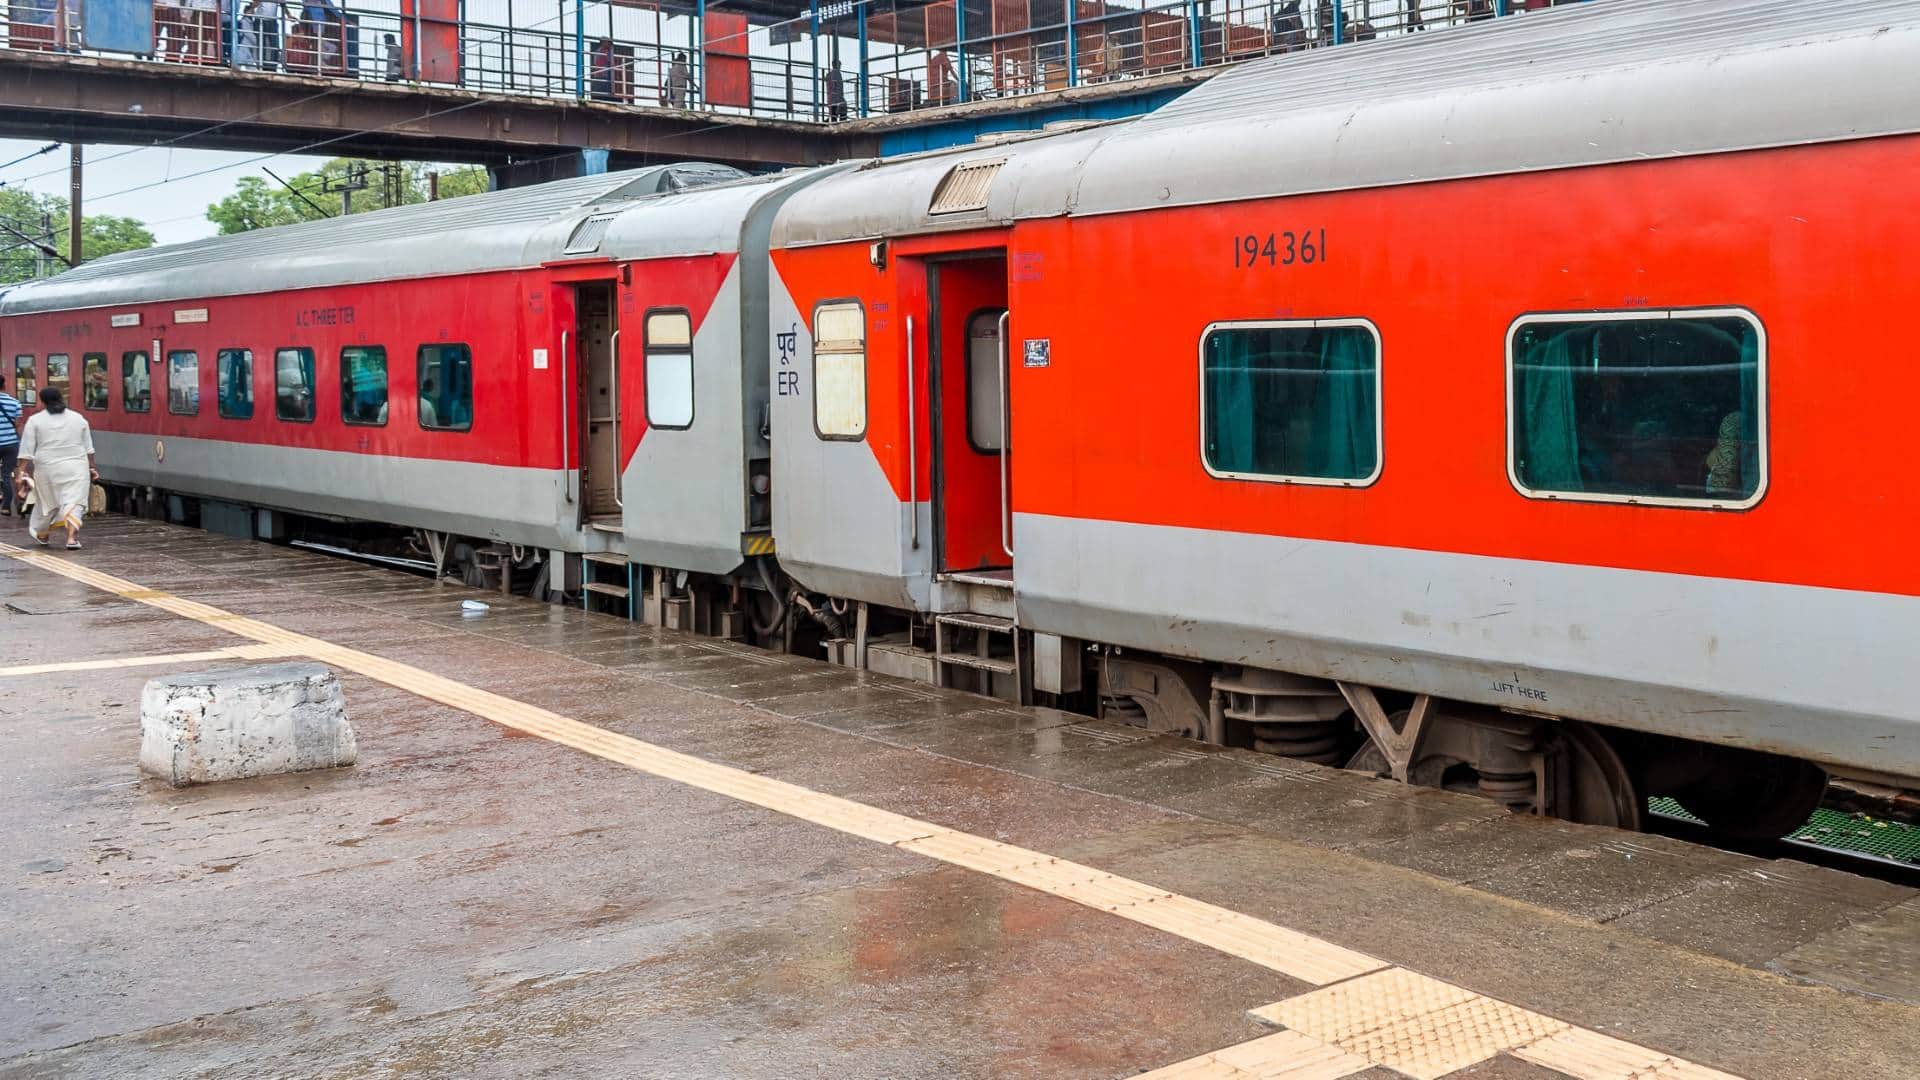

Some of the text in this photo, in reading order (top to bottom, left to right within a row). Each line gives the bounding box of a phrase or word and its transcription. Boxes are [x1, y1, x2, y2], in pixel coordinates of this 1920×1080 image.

[1234, 228, 1326, 269] 194361
[776, 322, 798, 366] पूर्व
[778, 371, 800, 396] ER
[1493, 681, 1548, 701] LIFT HERE
